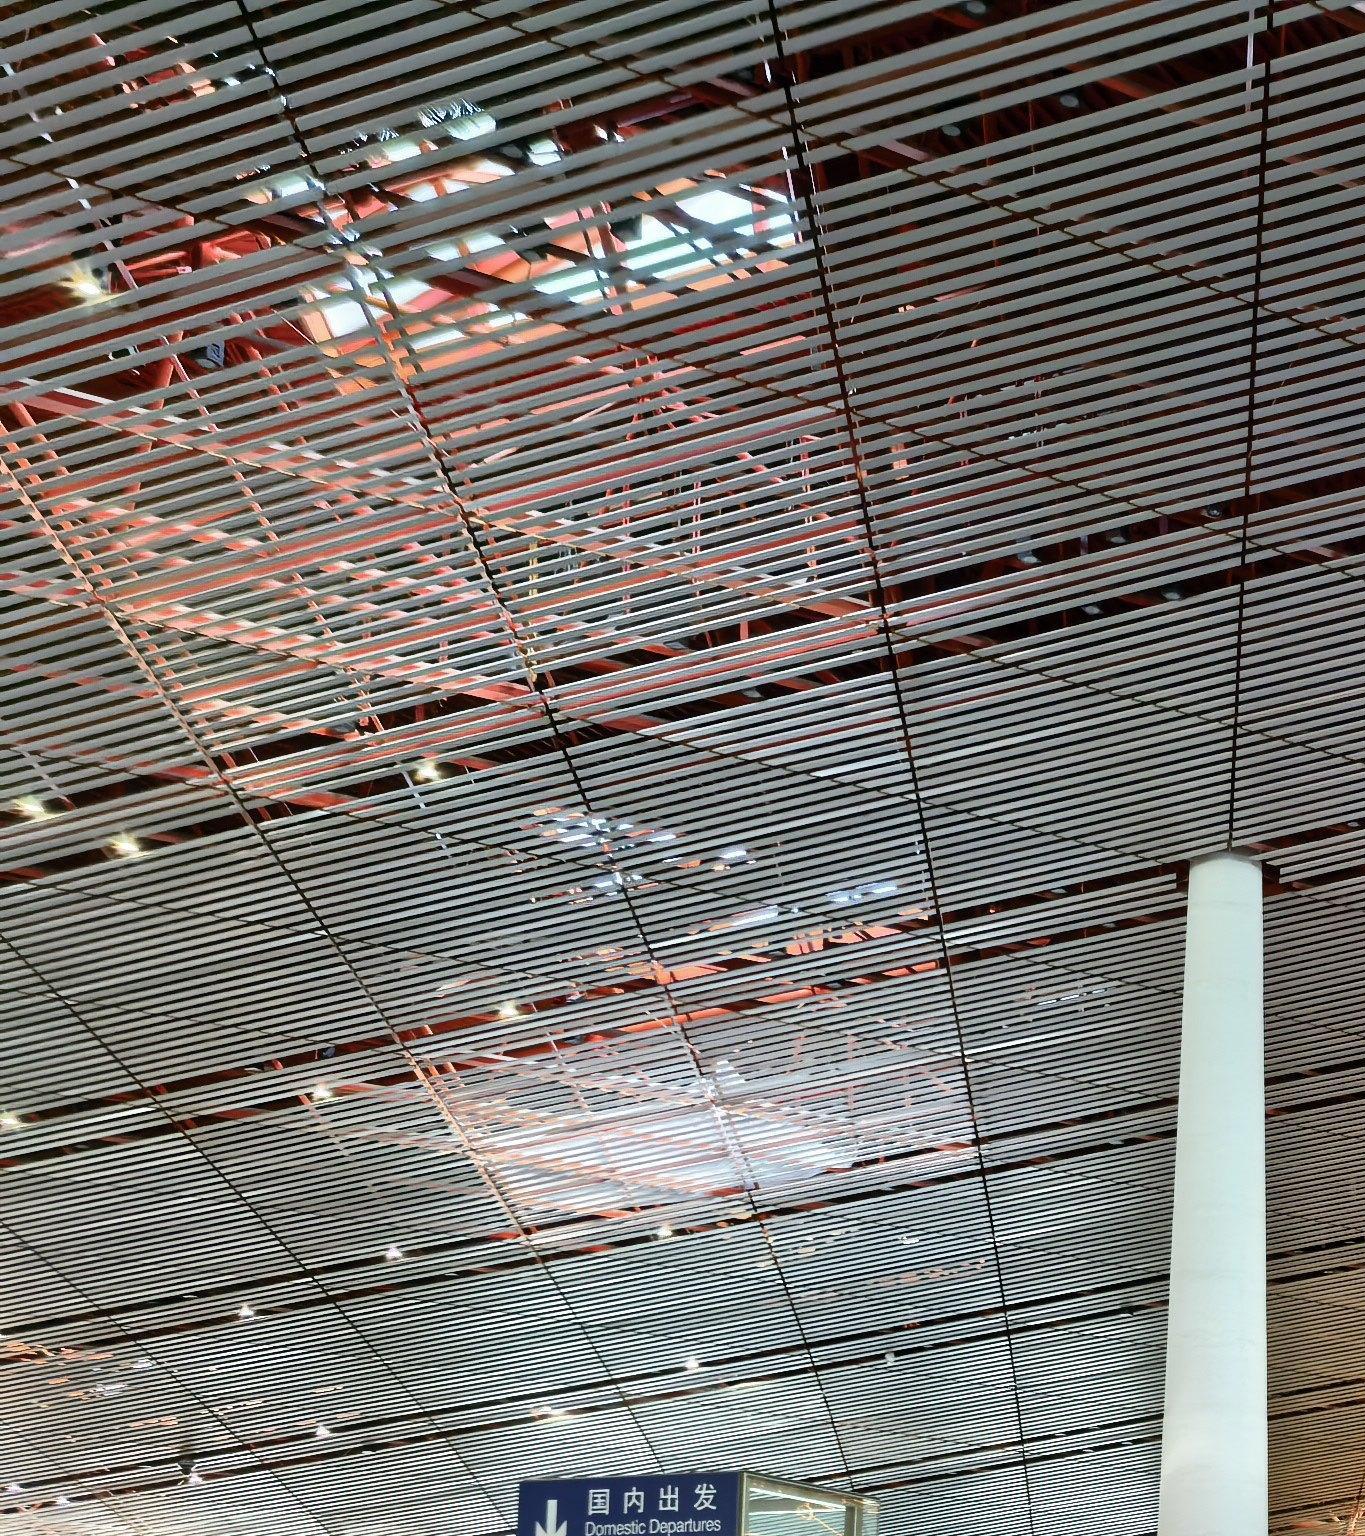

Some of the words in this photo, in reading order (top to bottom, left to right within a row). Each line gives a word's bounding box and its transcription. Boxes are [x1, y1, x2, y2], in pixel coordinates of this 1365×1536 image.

[587, 1483, 717, 1516] 国内出发
[585, 1520, 647, 1536] Domestic
